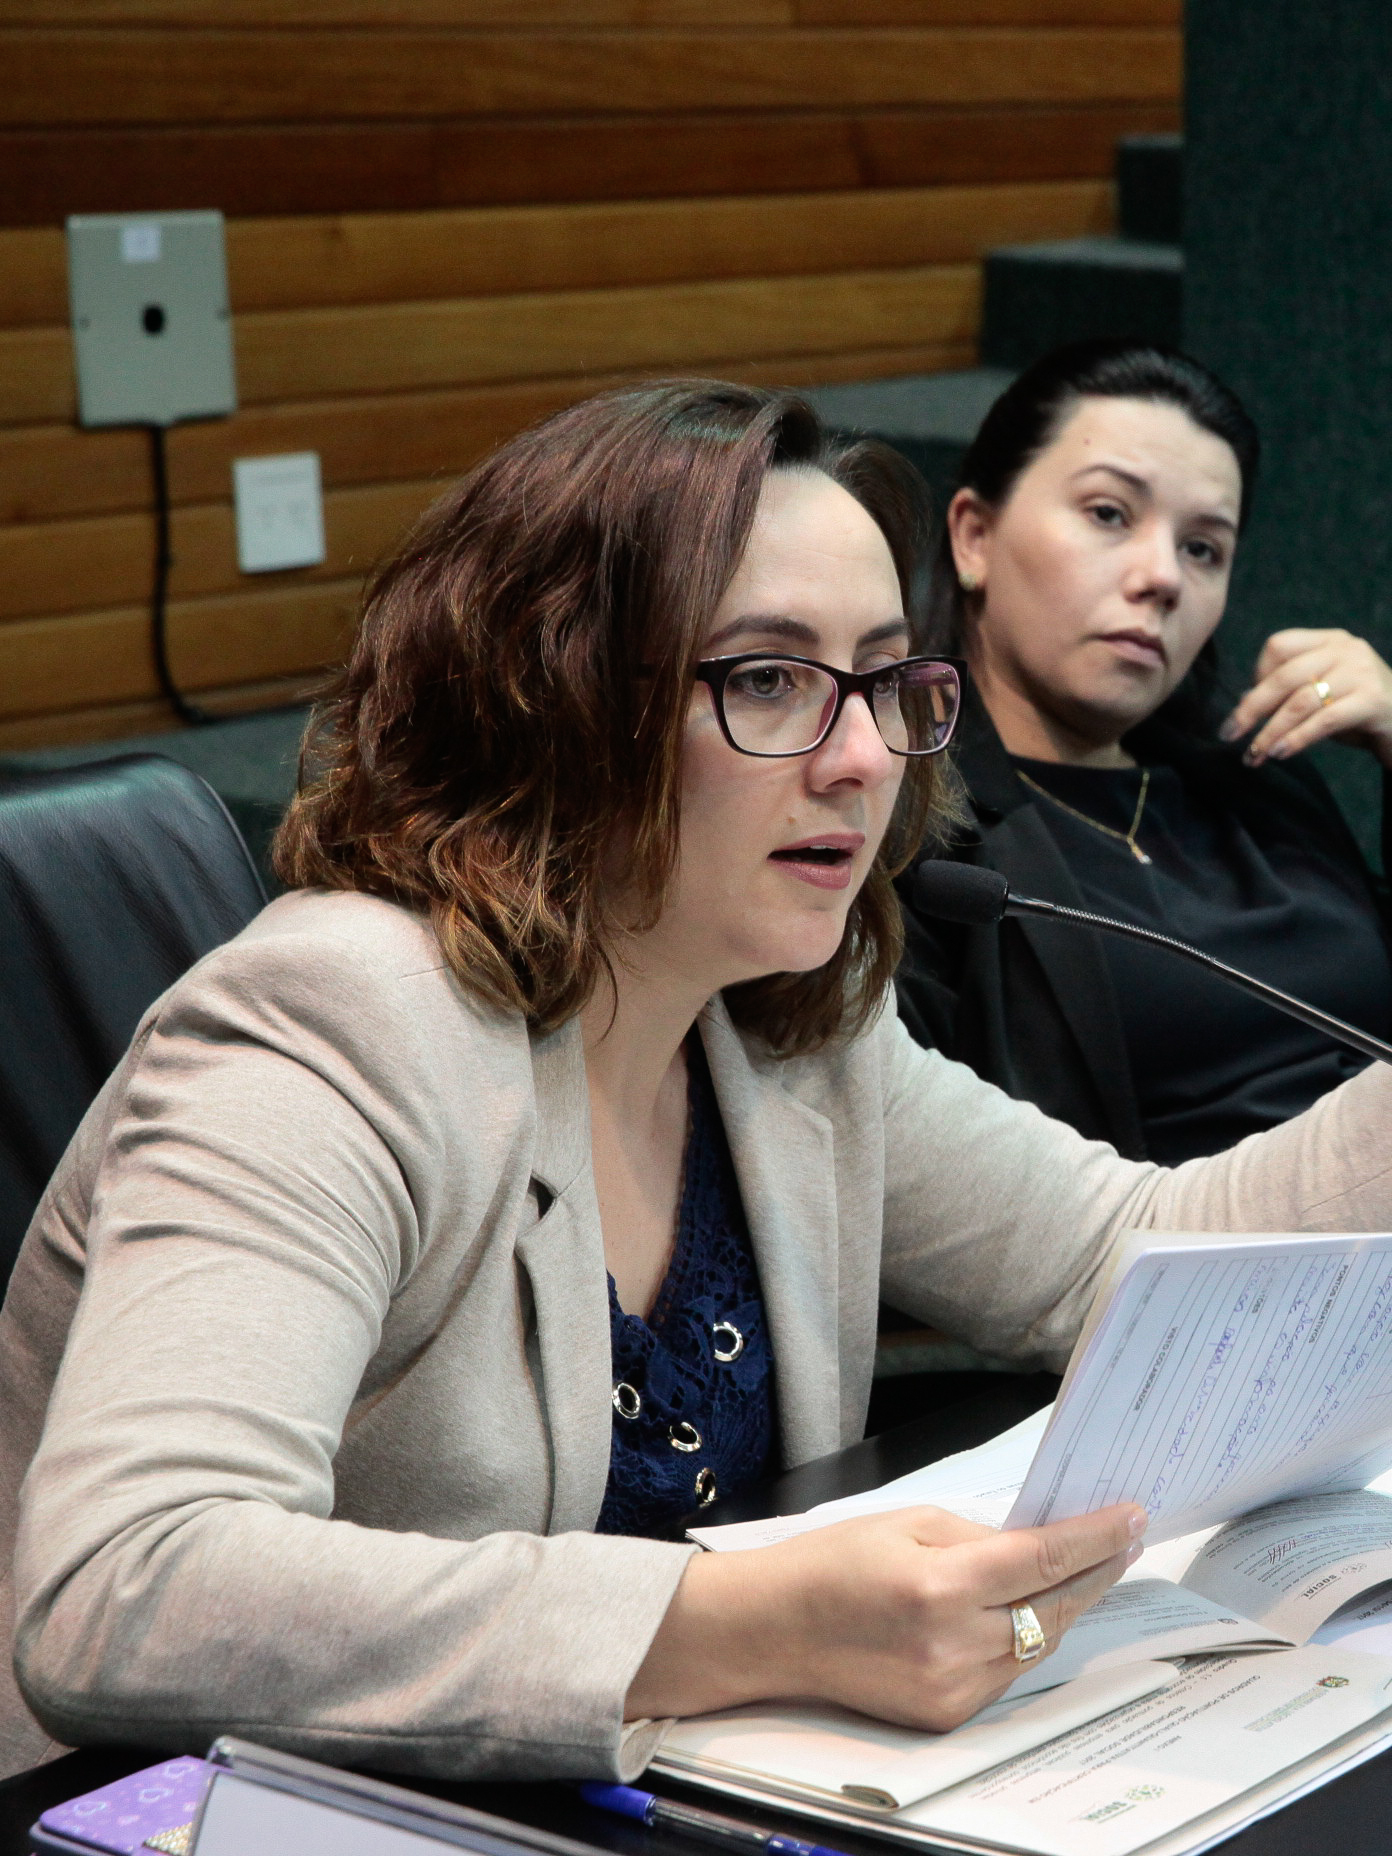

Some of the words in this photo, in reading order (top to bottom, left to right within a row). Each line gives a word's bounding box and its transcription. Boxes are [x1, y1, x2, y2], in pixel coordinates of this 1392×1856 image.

[1327, 1264, 1349, 1297] PONTOS
[1305, 1298, 1334, 1345] NEGATIVOS
[1130, 1350, 1167, 1413] COLABORADOR
